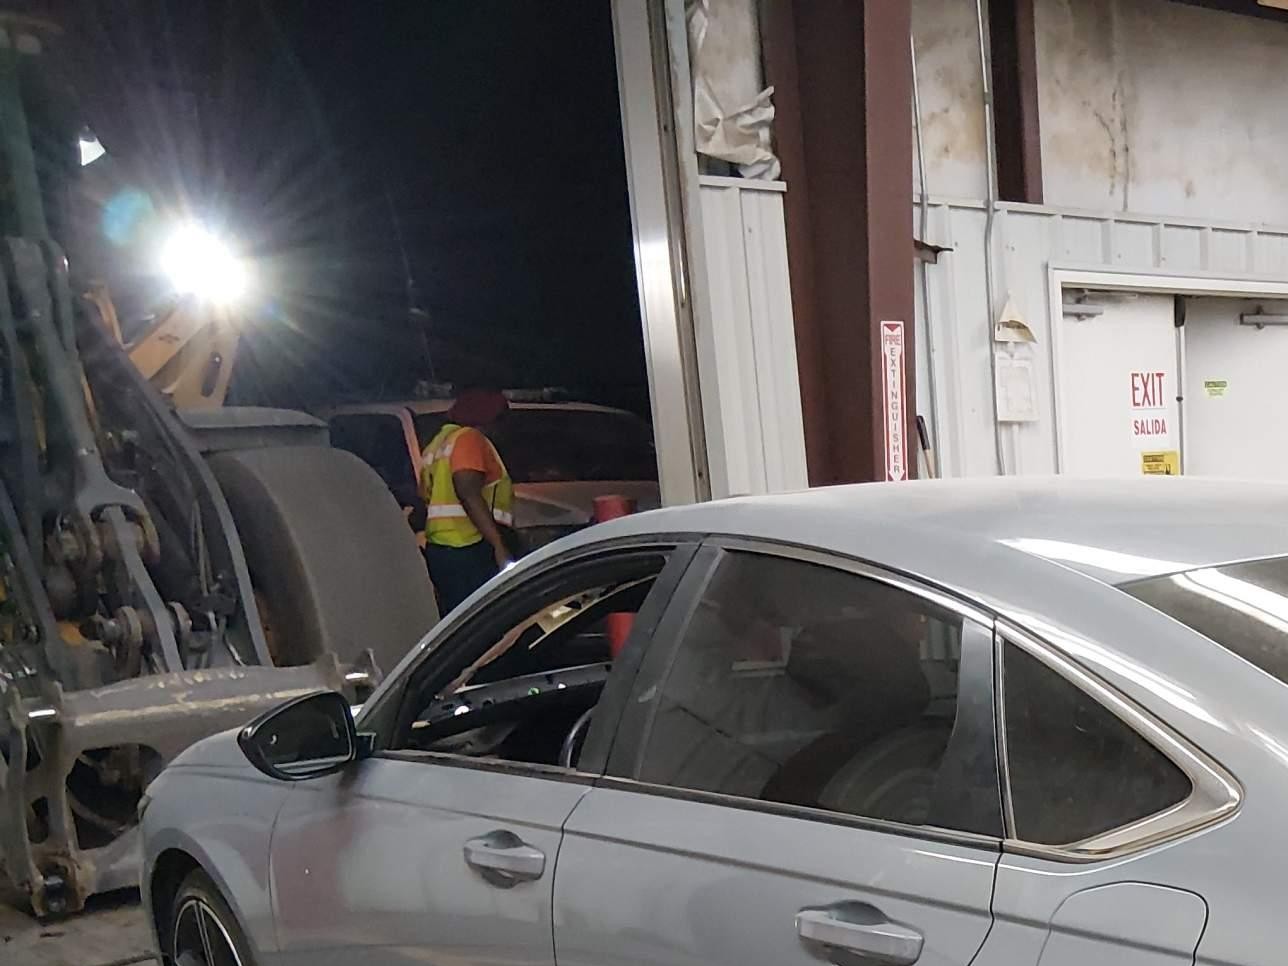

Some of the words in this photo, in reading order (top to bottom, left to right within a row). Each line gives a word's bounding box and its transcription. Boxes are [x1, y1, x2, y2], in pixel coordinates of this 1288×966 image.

[885, 334, 901, 346] FIRE
[1131, 372, 1165, 407] EXIT
[889, 347, 901, 473] EXTINGUISHER
[1133, 419, 1167, 436] SALIDA
